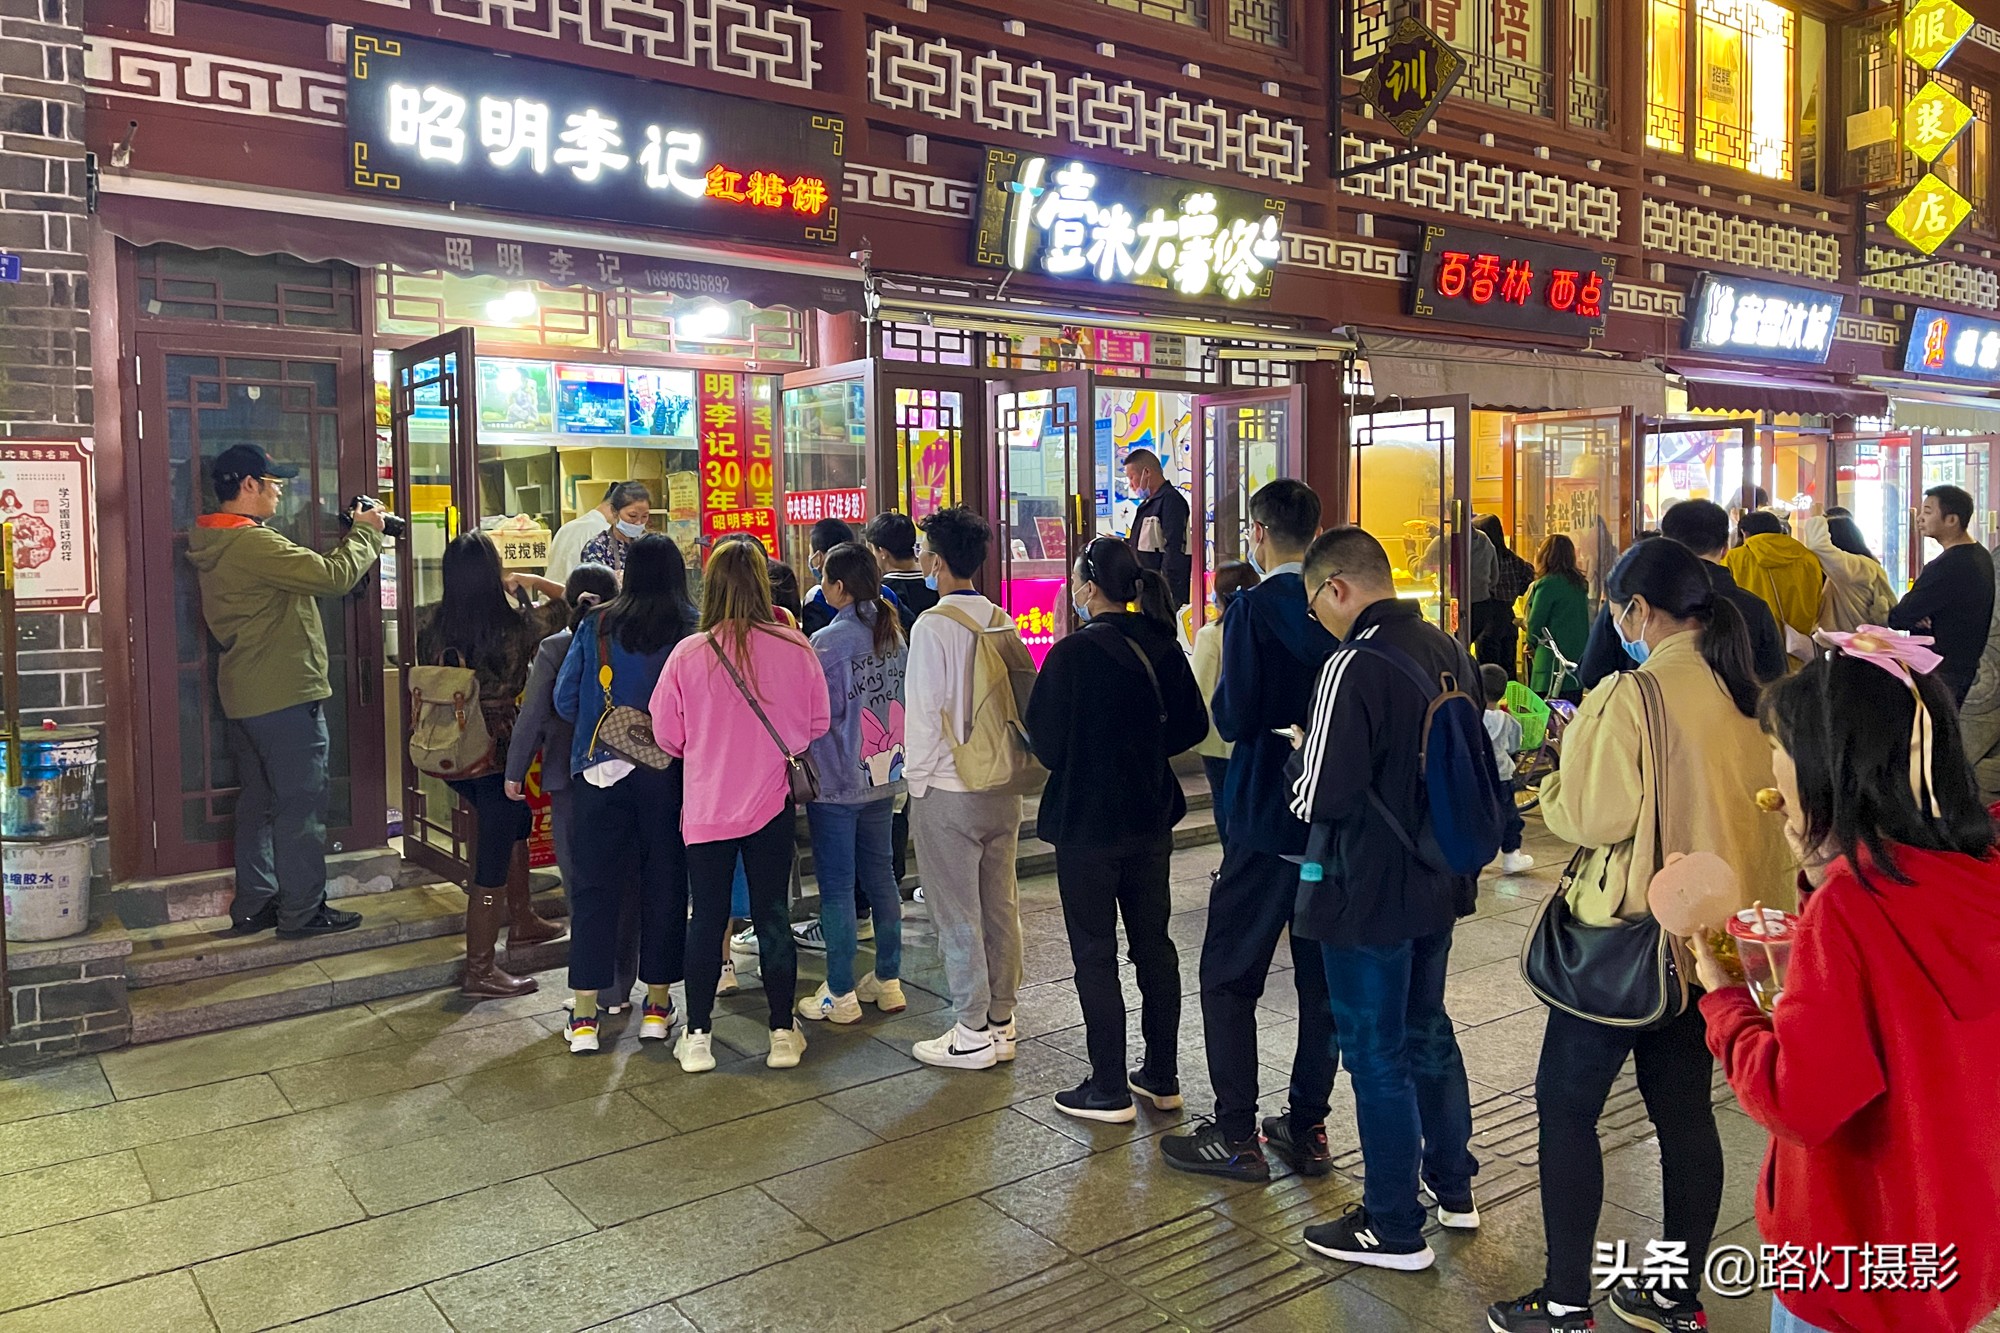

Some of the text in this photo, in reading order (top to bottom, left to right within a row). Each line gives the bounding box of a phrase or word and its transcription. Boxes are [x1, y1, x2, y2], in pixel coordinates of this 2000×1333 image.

[1385, 49, 1427, 102] 训
[1912, 13, 1953, 234] 服装店
[388, 83, 706, 199] 昭明李记
[704, 164, 829, 214] 红糖饼
[445, 237, 622, 285] 昭明李记
[644, 269, 731, 294] 18986396892
[1440, 251, 1603, 317] 百香林 西点
[0, 450, 70, 460] 北旅游名街
[712, 511, 770, 530] 昭明李记
[503, 541, 547, 560] 搅搅糖
[851, 651, 898, 676] Are you
[869, 679, 900, 708] me?
[1354, 1228, 1380, 1249] N
